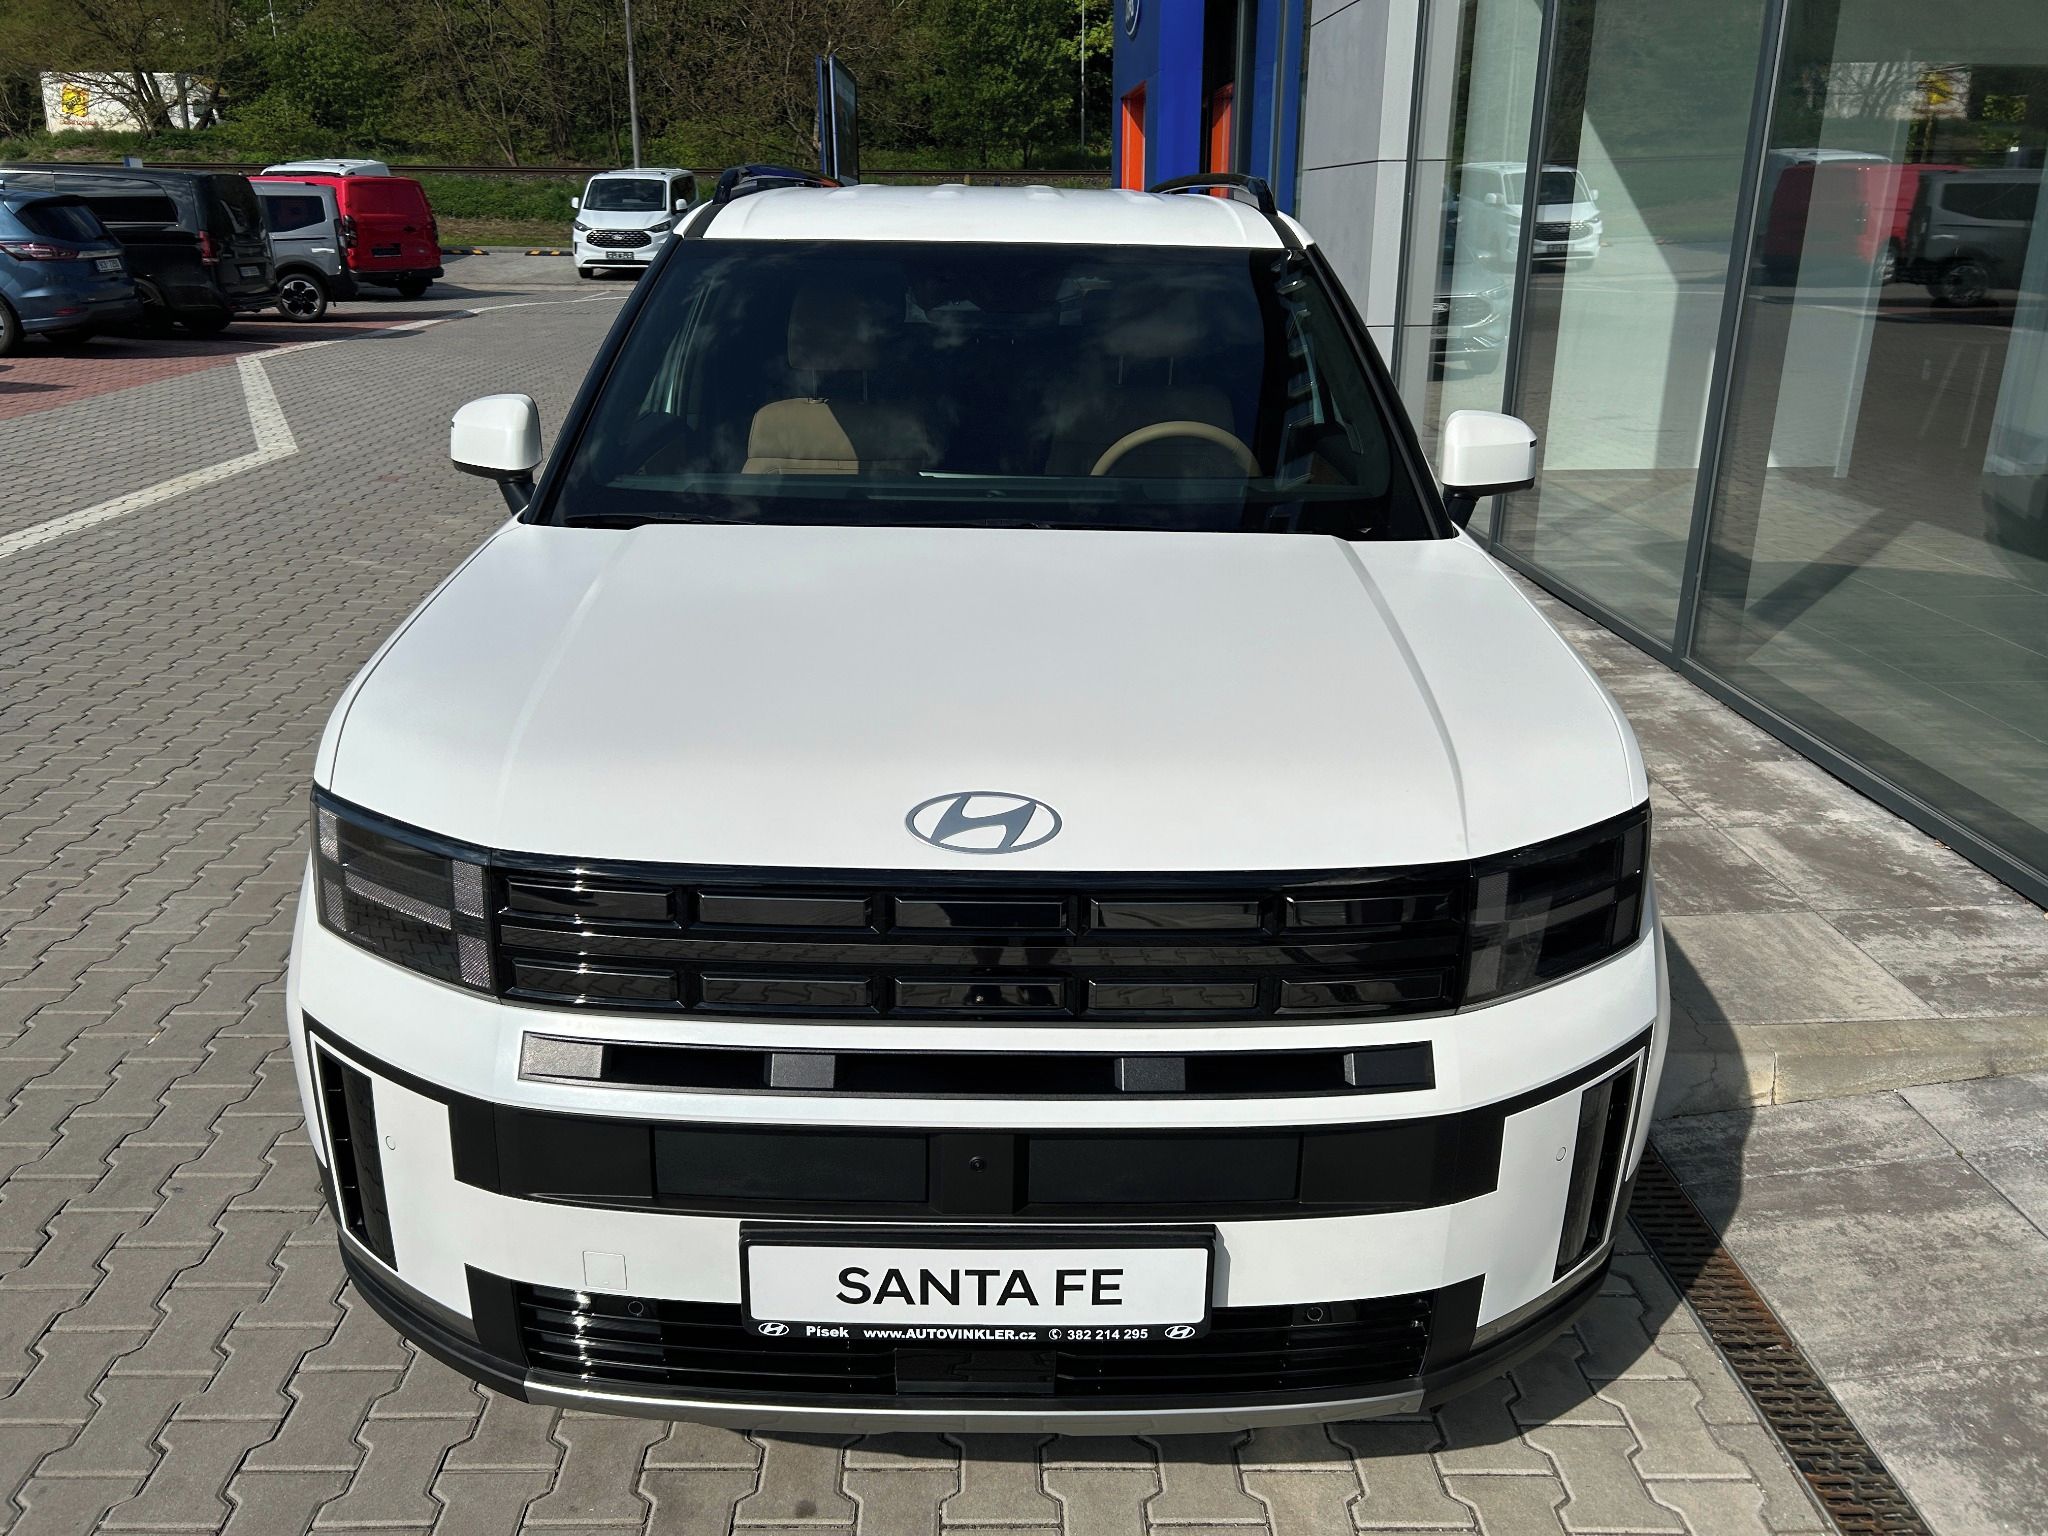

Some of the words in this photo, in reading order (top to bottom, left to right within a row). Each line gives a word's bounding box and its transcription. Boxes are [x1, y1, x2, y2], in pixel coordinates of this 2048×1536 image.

[835, 1266, 1040, 1306] SANTA
[1055, 1268, 1124, 1306] FE
[805, 1325, 850, 1338] Písek
[863, 1328, 1037, 1340] www.AUTOVINKLER.cz
[1067, 1329, 1092, 1341] 382
[1095, 1329, 1121, 1340] 214
[1123, 1328, 1149, 1340] 295
